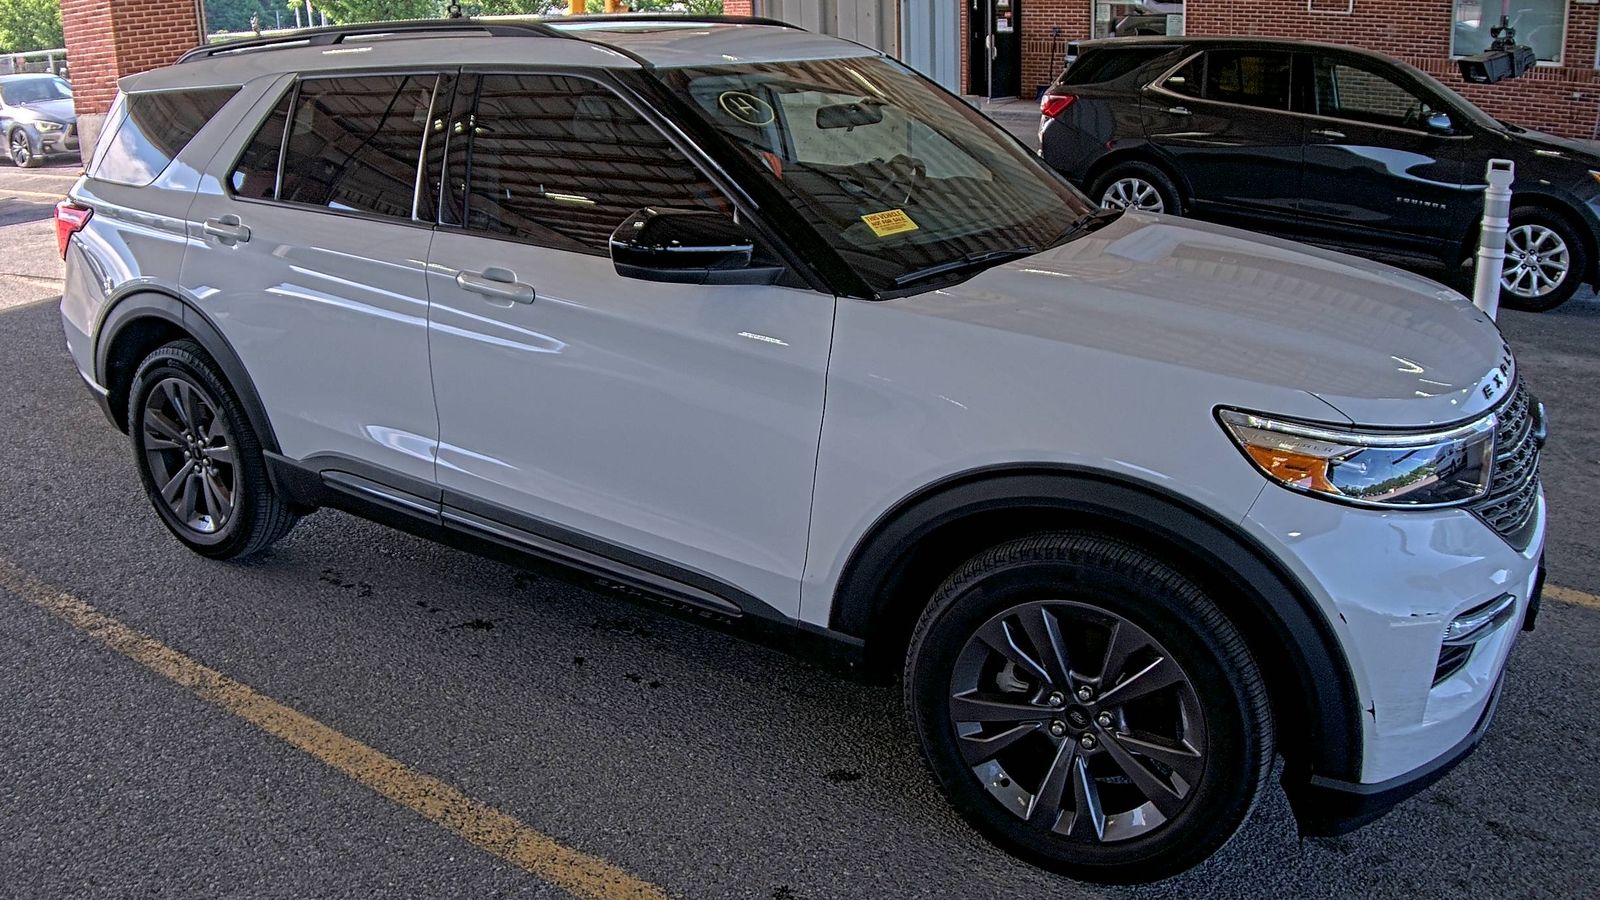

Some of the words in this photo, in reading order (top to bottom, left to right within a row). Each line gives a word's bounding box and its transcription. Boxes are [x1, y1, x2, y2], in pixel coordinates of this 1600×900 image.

[729, 97, 760, 115] H
[1396, 196, 1447, 209] EQUINOX
[879, 211, 902, 219] VEHICLE
